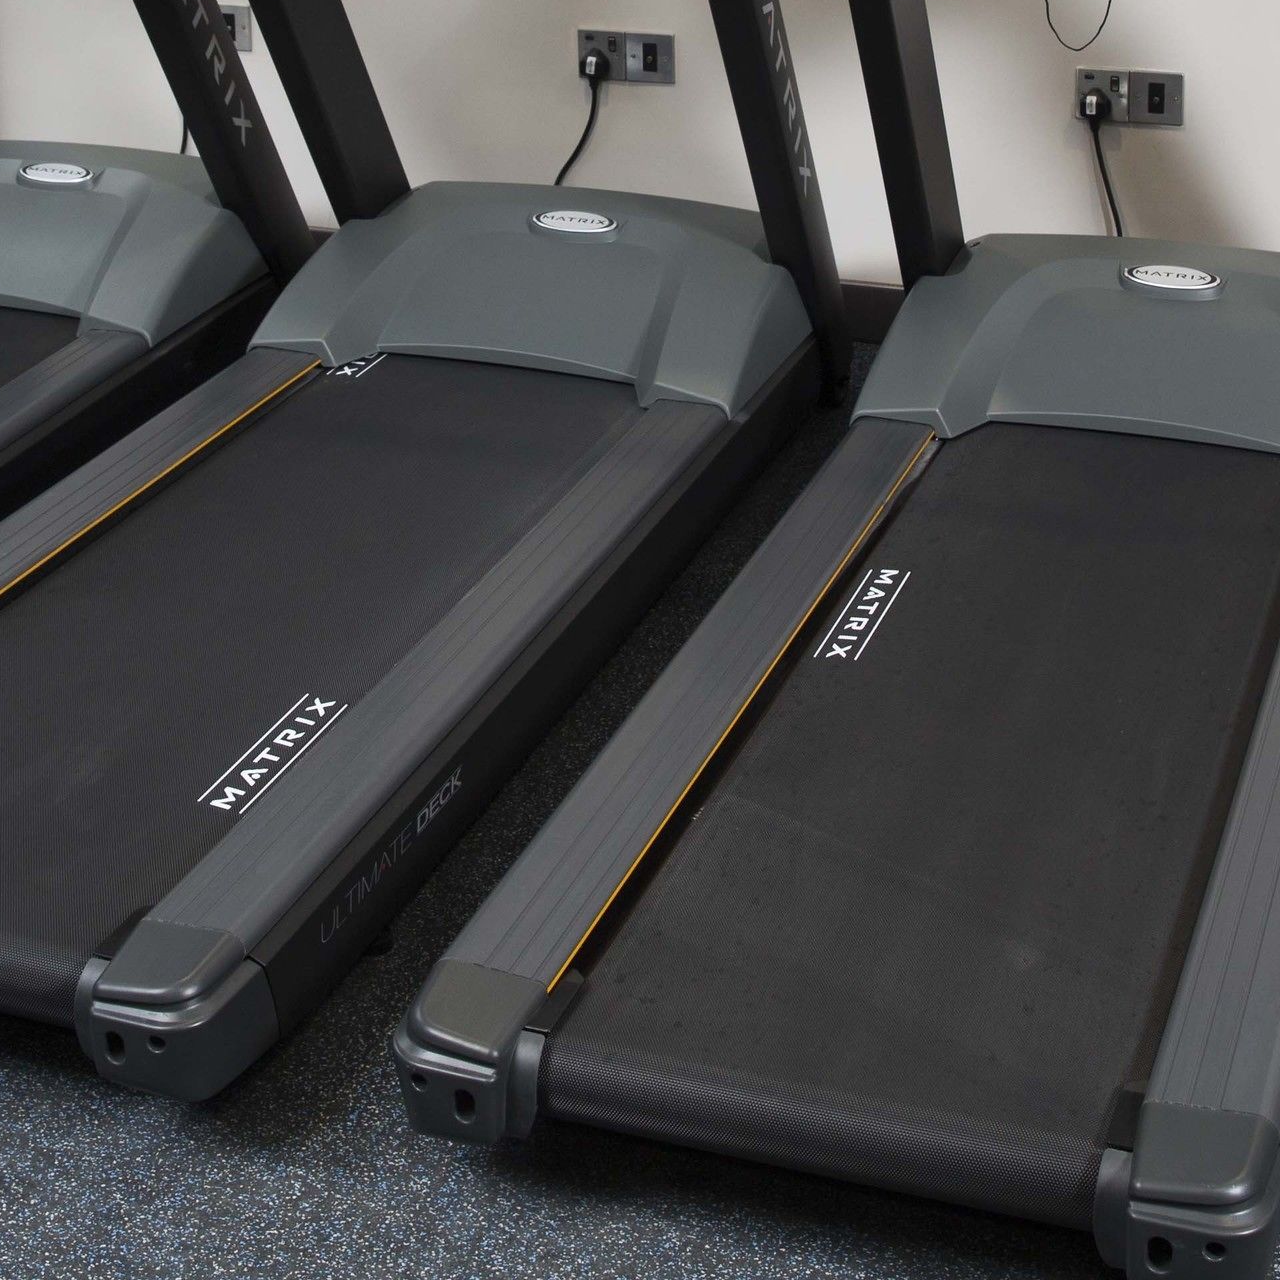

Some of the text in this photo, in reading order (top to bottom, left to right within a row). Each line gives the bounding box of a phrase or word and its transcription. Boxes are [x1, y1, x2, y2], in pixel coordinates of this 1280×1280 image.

[542, 214, 606, 226] MATRIX
[1135, 269, 1208, 281] MATRIX
[825, 568, 900, 659] MATRIX
[209, 696, 337, 811] MATRIX
[320, 765, 463, 944] ULTIMATE DECK
